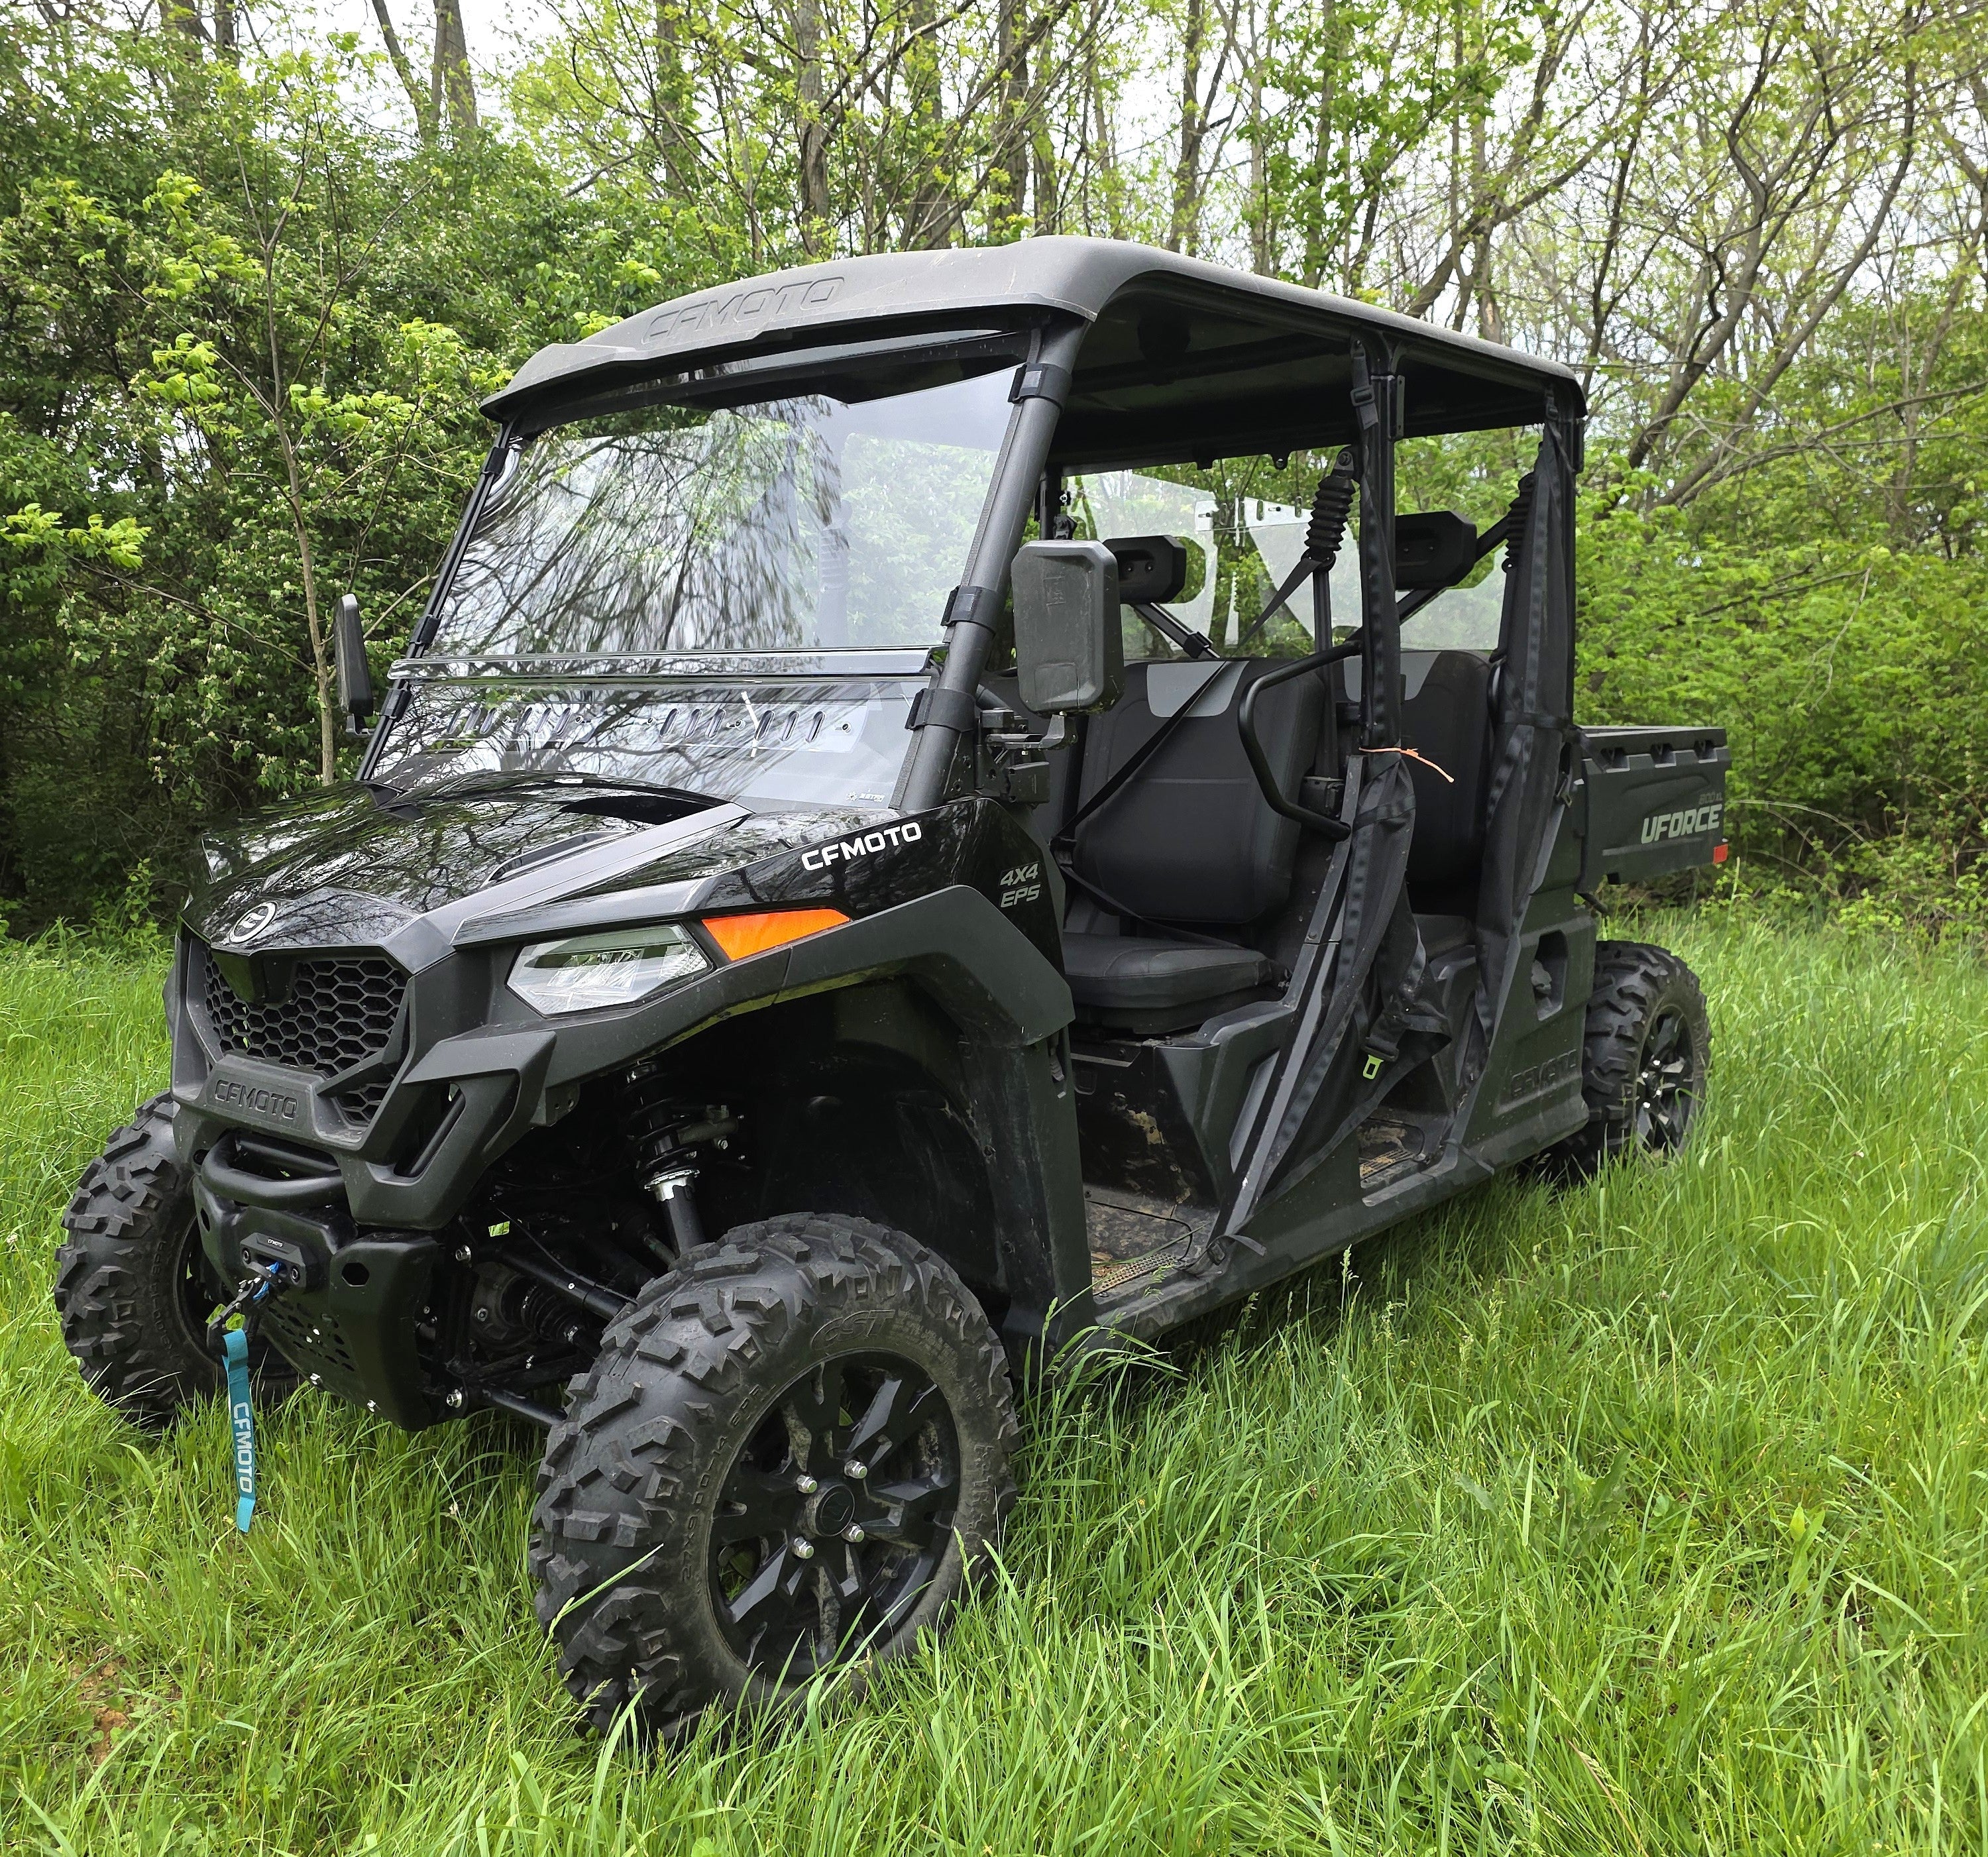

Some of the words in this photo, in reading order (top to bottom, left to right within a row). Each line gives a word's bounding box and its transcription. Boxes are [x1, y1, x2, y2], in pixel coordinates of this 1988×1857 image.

[641, 276, 845, 345] CFMOTO
[1641, 804, 1723, 844] UFORCE
[801, 822, 922, 872] CFMOTO
[1000, 863, 1038, 886] 4X4
[1001, 884, 1041, 908] EPS
[214, 1079, 298, 1120] CFMOTO
[267, 1239, 283, 1247] CFMOTO
[810, 1309, 896, 1351] CST
[233, 1402, 254, 1493] CFMOTO
